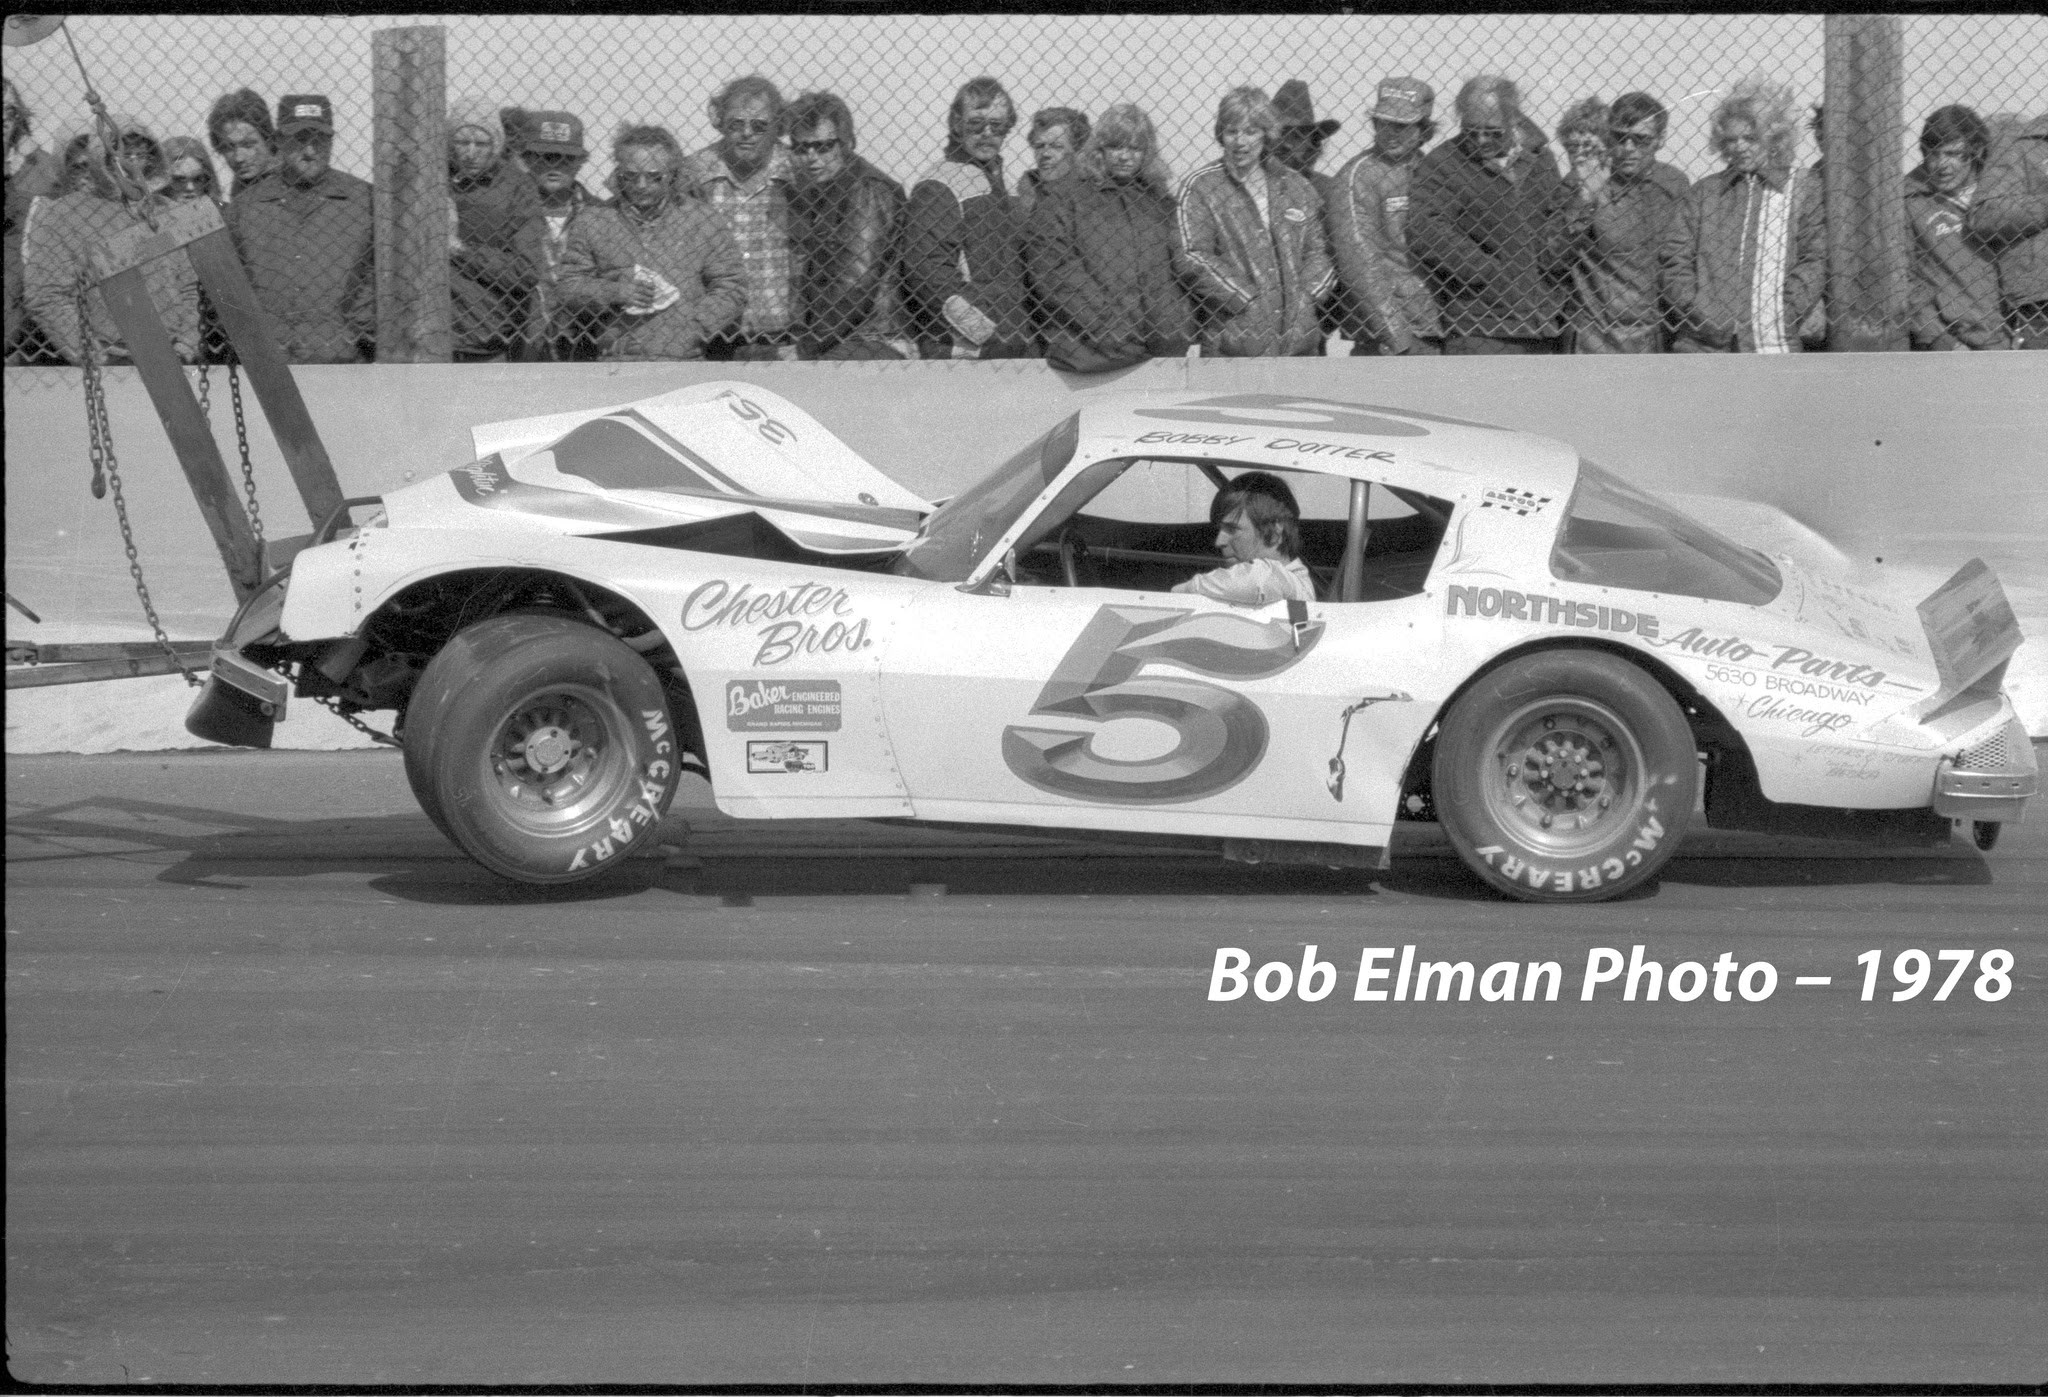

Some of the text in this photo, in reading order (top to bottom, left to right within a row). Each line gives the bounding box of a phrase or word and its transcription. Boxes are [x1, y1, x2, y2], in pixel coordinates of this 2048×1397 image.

[1134, 431, 1396, 464] BOBBY DOTTER
[681, 579, 853, 631] Chester
[1447, 584, 1660, 638] NORTHSIDE
[752, 617, 871, 667] Bros.
[728, 680, 840, 716] Baker ENGINEERED
[1000, 603, 1327, 806] 5
[1705, 664, 1875, 706] 5630 BROADWAY
[774, 704, 841, 715] RACING ENGINES
[1747, 695, 1857, 738] Chicago
